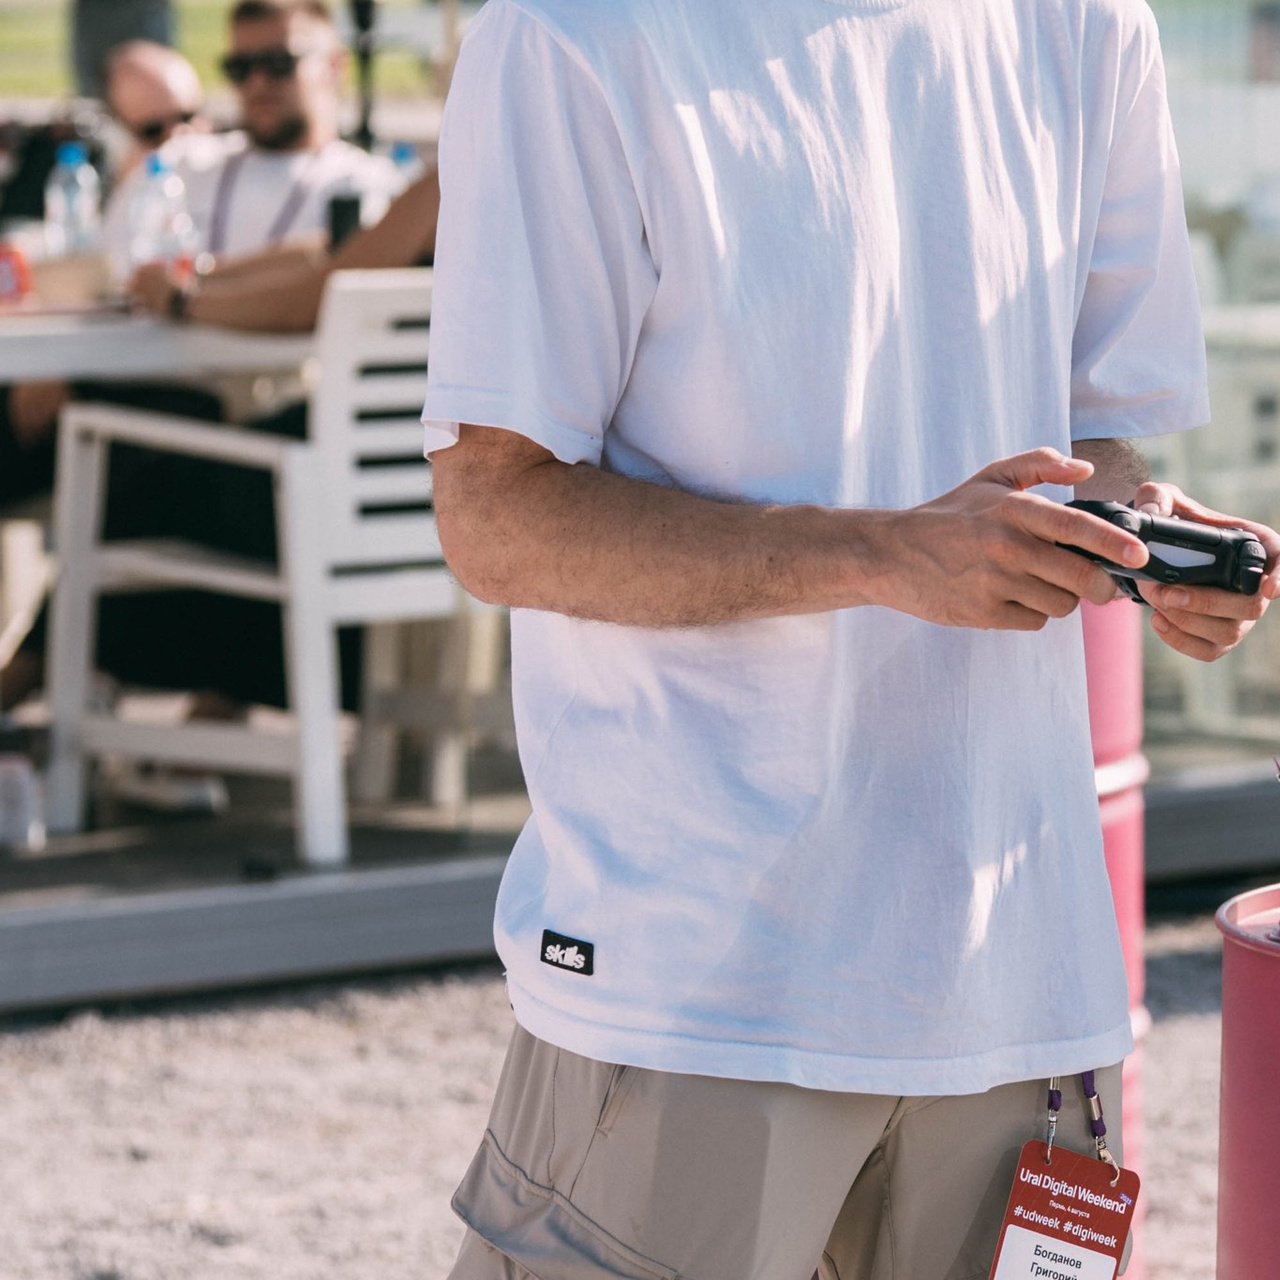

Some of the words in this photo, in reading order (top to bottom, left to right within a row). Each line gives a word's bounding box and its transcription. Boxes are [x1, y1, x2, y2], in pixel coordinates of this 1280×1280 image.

[1019, 1168, 1043, 1186] Ural
[1042, 1175, 1077, 1198] Digital
[1078, 1186, 1126, 1214] Weekend
[1014, 1205, 1060, 1230] #udweek
[1062, 1221, 1117, 1248] #digiweek
[1033, 1244, 1082, 1269] Богданов
